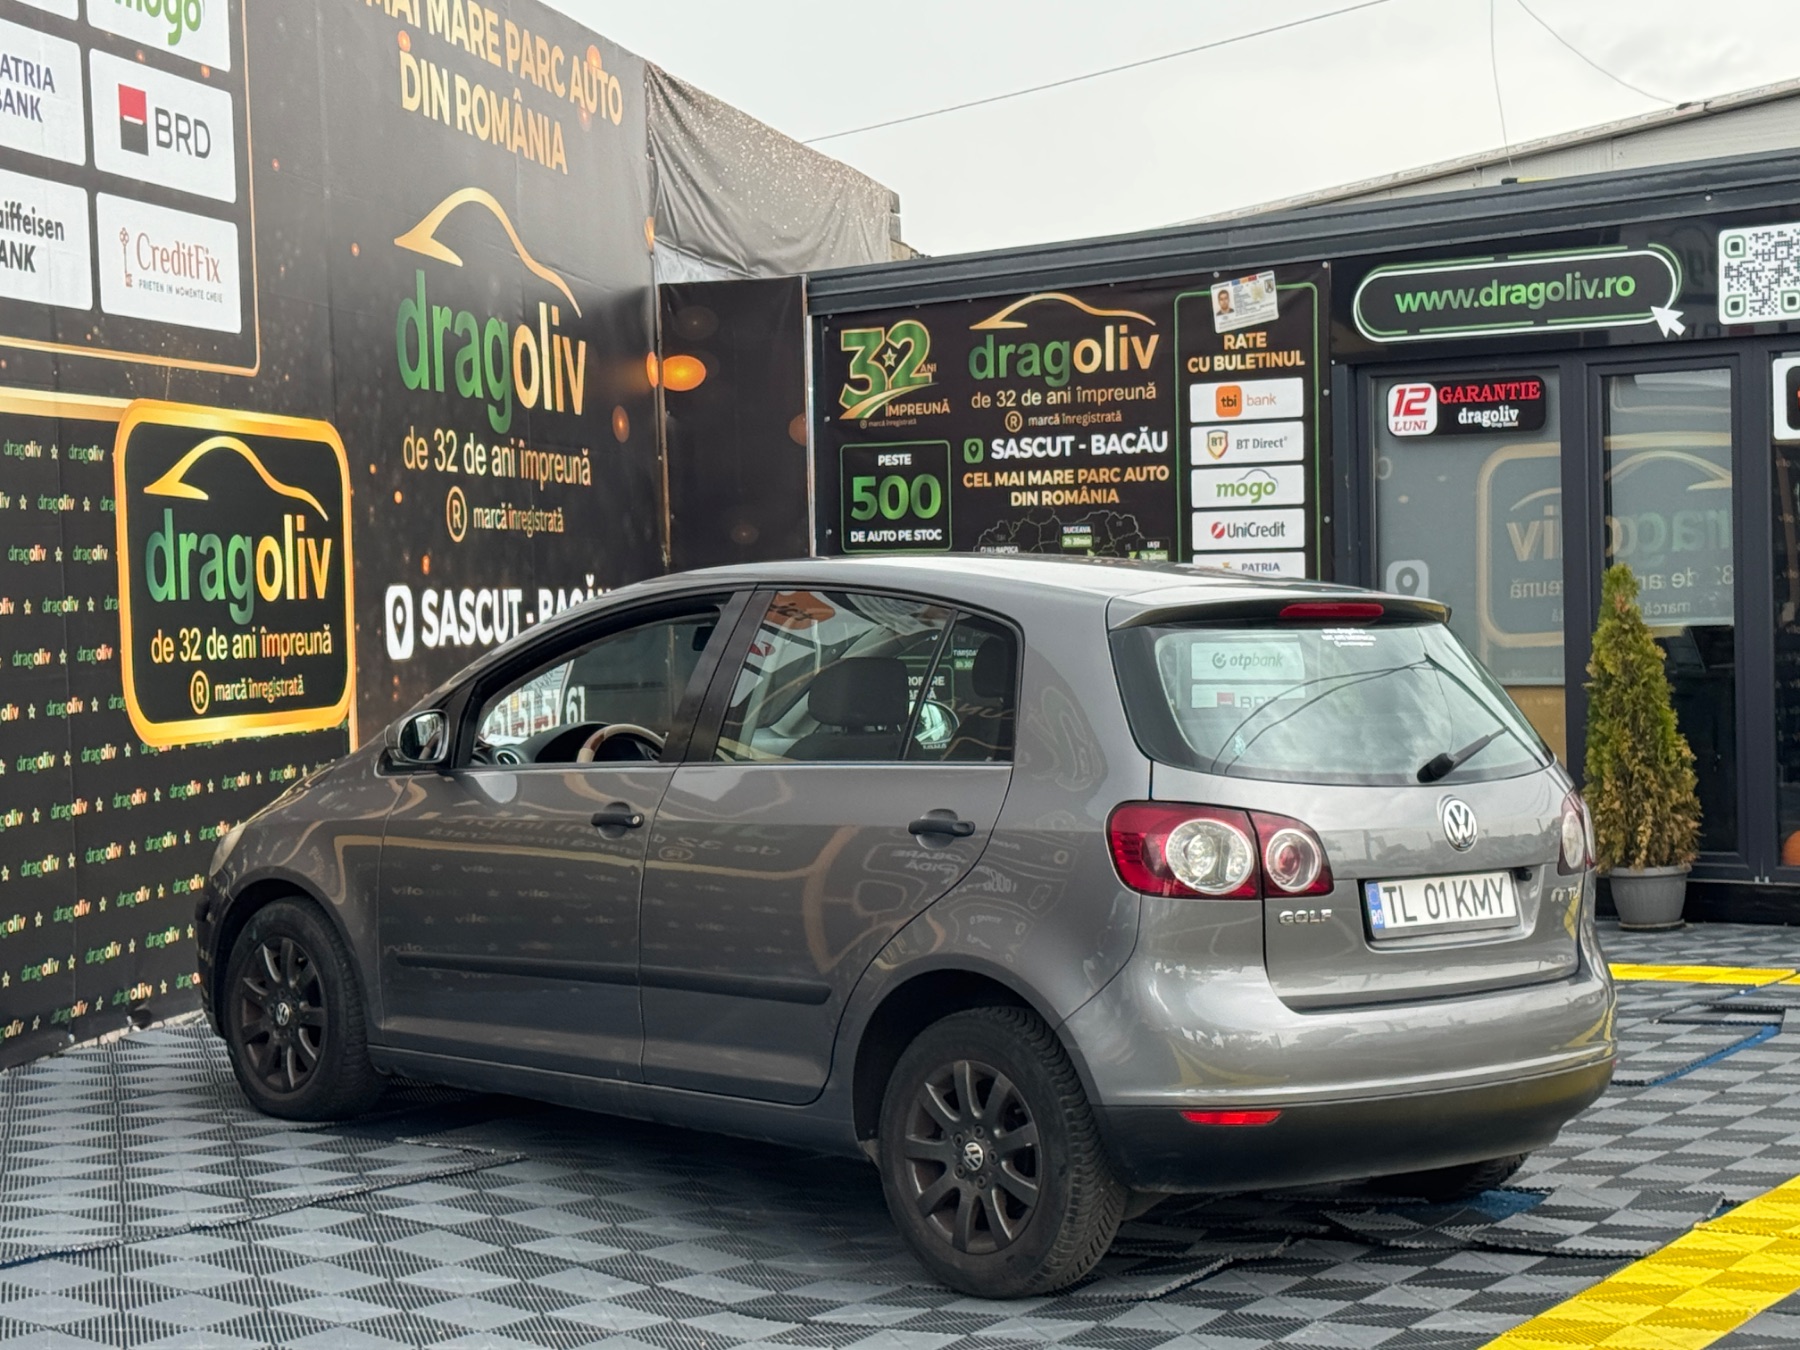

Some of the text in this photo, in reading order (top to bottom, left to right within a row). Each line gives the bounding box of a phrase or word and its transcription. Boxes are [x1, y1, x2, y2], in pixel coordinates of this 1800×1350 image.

[0, 54, 55, 93] ATRIA
[505, 19, 566, 98] PARC
[570, 55, 623, 125] AUTO
[0, 88, 42, 123] ANK
[400, 50, 568, 175] DIN ROMÂNIA
[155, 107, 211, 159] BRD
[0, 239, 36, 273] ANK
[137, 232, 221, 283] CreditFix
[1394, 272, 1636, 315] www.dragoliv.ro
[396, 269, 586, 434] dragoliv
[968, 325, 1160, 387] dragoliv
[1224, 332, 1267, 350] RATE
[839, 319, 931, 410] 32
[1187, 350, 1306, 373] CU BULETINUL
[885, 398, 951, 417] ÎMPREUNĂ
[971, 381, 1157, 410] de 32 de ani împreună
[1221, 394, 1277, 408] tbi bank
[1393, 381, 1541, 417] 12 GARANTIE
[1028, 411, 1060, 427] marcă
[1061, 410, 1122, 427] înregistrată
[1394, 420, 1428, 432] LUNI
[1458, 405, 1519, 427] dragoliv
[4, 439, 104, 464] dragoliv dragoliv
[991, 435, 1075, 460] SASCUT
[1091, 426, 1168, 456] BACĂU
[1211, 436, 1224, 447] BT
[1236, 438, 1250, 450] BT
[403, 426, 591, 491] de 32 de ani împreună
[878, 454, 912, 467] PESTE
[963, 465, 1170, 488] CEL MAI MARE PARC AUTO
[1216, 478, 1277, 503] mogo
[37, 494, 75, 514] dragoliv
[851, 474, 942, 521] 500
[1011, 486, 1120, 507] DIN ROMÂNIA
[473, 502, 507, 530] marcă
[508, 502, 564, 538] înregistrată
[1227, 521, 1286, 539] UniCredit
[850, 528, 943, 543] DE AUTO PE STOC
[8, 544, 109, 565] dragoliv dragoliv
[145, 508, 332, 625] dragoliv
[1241, 563, 1281, 573] PATRIA
[42, 595, 79, 617] dragoliv
[422, 588, 522, 648] SASCUT
[12, 643, 113, 670] dragoliv dragoliv
[151, 624, 332, 664] de 32 de ani împreună
[1230, 652, 1283, 670] otpbank
[214, 678, 247, 702] marcă
[248, 674, 304, 703] înregistrată
[46, 697, 84, 719] dragoliv
[16, 751, 55, 774] dragoliv
[81, 743, 117, 765] dragoliv
[50, 798, 88, 821] dragoliv
[112, 788, 147, 810] dragoliv
[20, 854, 60, 878] dragoliv
[85, 842, 122, 864] dragoliv
[53, 899, 91, 923] dragoliv
[116, 885, 151, 908] dragoliv
[172, 873, 205, 895] dragoliv
[1383, 876, 1505, 923] TL 01 KMY
[1279, 909, 1332, 925] GOLF
[1372, 909, 1384, 925] RO
[21, 925, 181, 983] dragoliv dragoliv dragoliv
